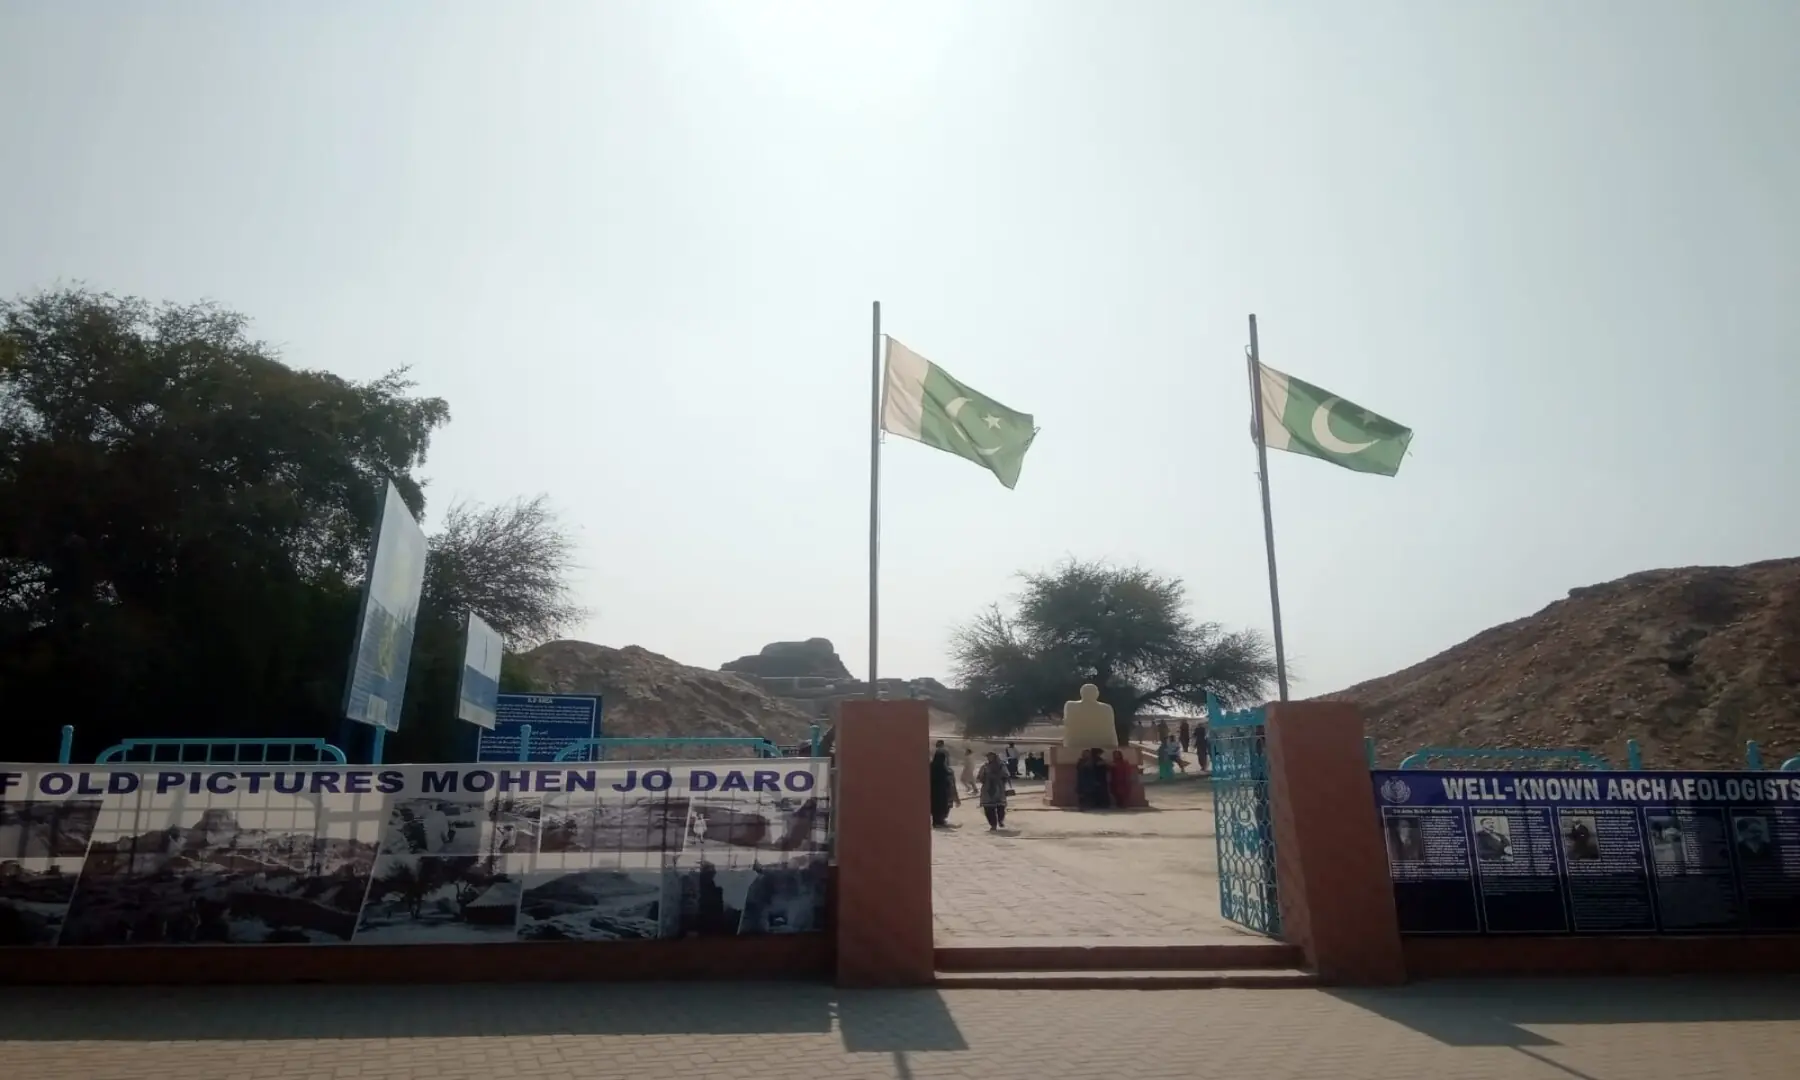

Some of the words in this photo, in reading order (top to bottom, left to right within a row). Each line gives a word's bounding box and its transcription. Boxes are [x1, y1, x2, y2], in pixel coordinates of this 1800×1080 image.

[40, 771, 140, 794] OLD
[157, 771, 404, 794] PICTURES
[421, 770, 596, 792] MOHEN
[612, 770, 673, 792] JO
[690, 770, 815, 792] DARO
[1442, 778, 1599, 801] WELL-KNOWN
[1607, 778, 1800, 801] ARCHAEOLOGISTS
